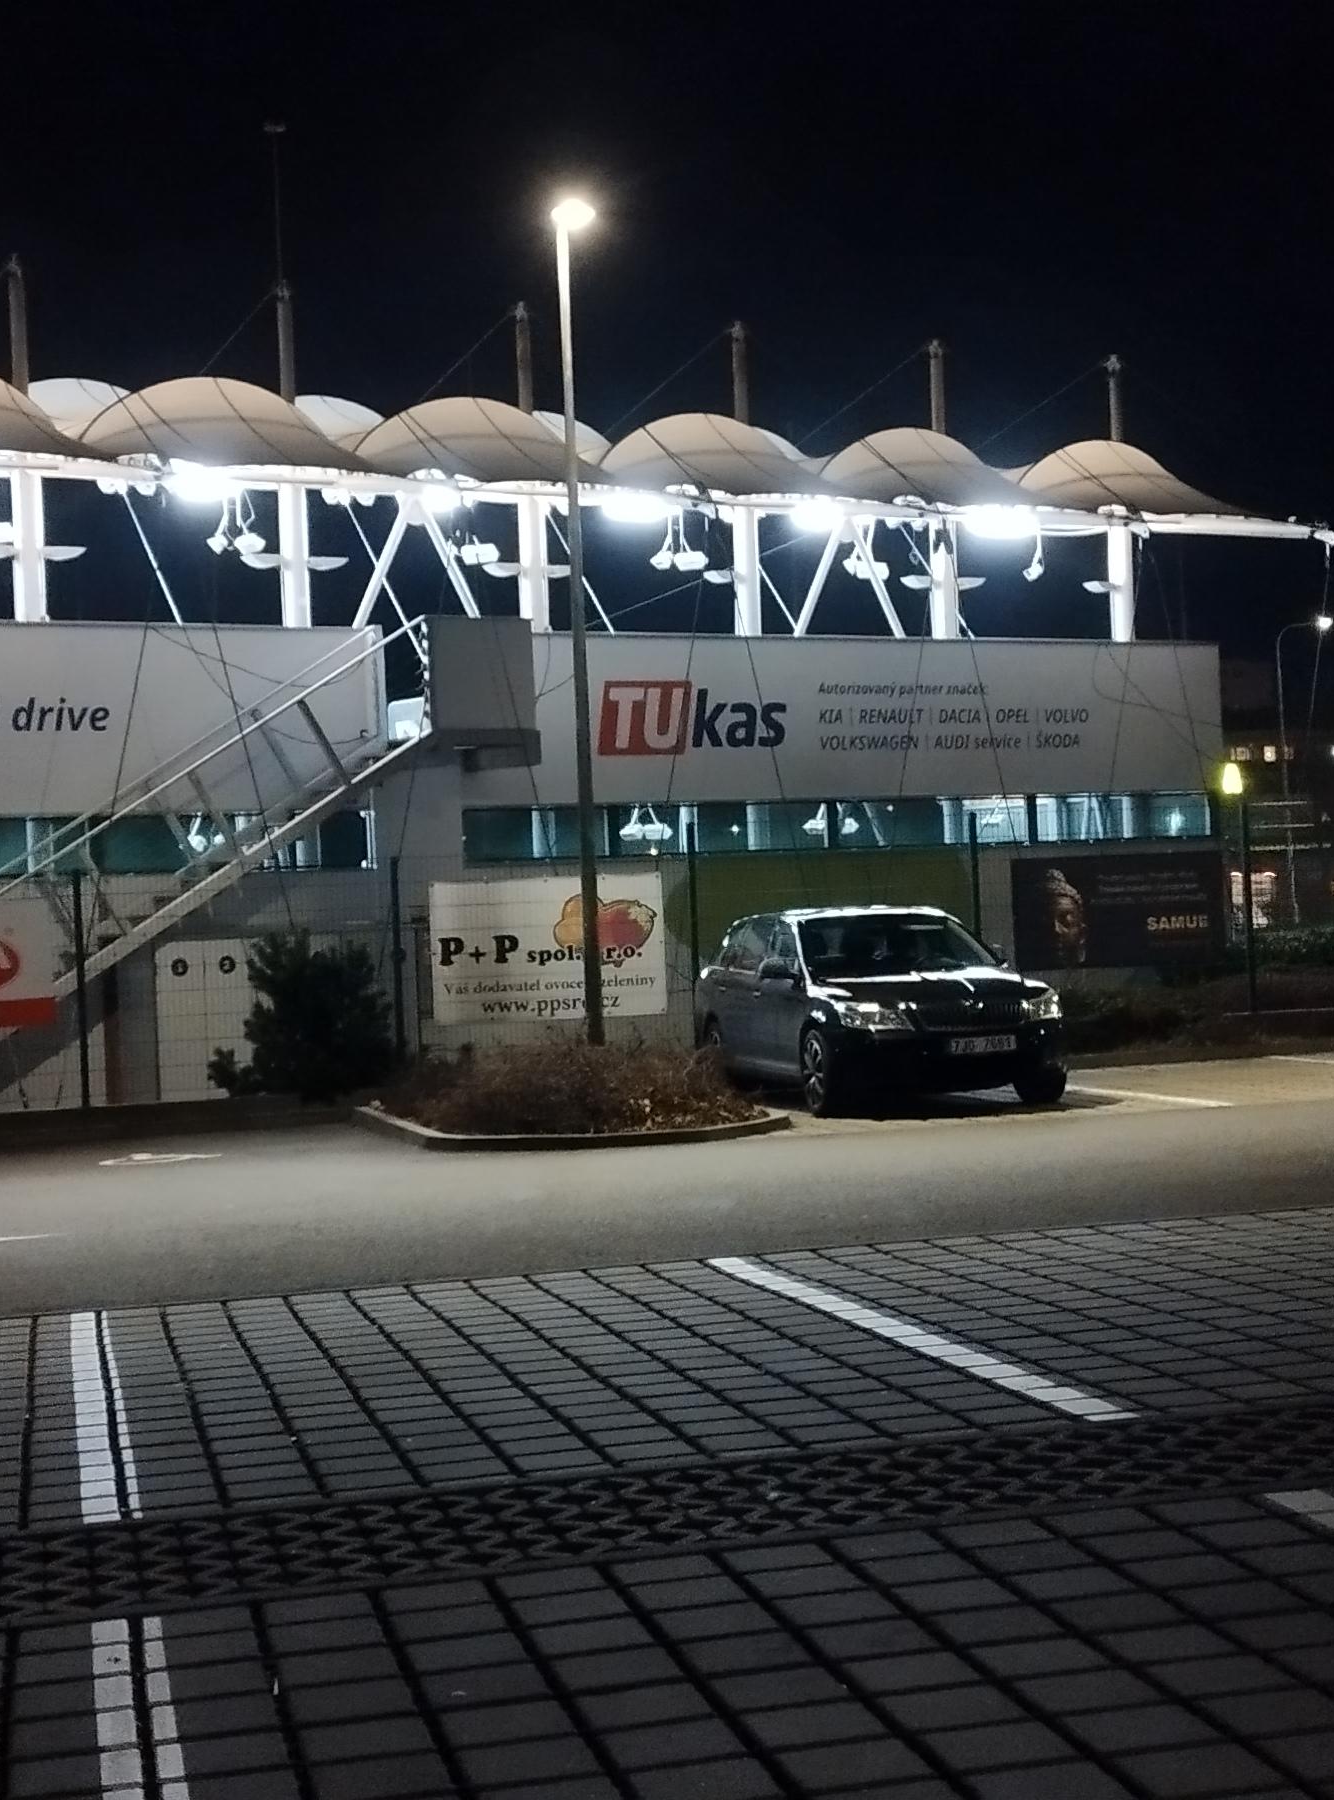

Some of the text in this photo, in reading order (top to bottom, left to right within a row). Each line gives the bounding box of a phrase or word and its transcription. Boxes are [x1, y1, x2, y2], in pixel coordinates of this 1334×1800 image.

[818, 682, 896, 697] Autorizovaný
[898, 683, 948, 697] partner
[12, 697, 110, 732] drive
[598, 681, 787, 755] TUkas
[818, 708, 1089, 724] KIA RENAULT DACIA OPEL VOLVO
[819, 730, 1081, 750] VOLKSWAGEN AUDI service ŠKODA
[438, 936, 465, 966] P
[469, 946, 487, 964] +
[492, 935, 519, 963] P
[527, 945, 581, 966] spol.
[473, 982, 541, 995] dodavatel
[544, 979, 585, 991] ovoce
[481, 995, 621, 1018] www.ppsrcz
